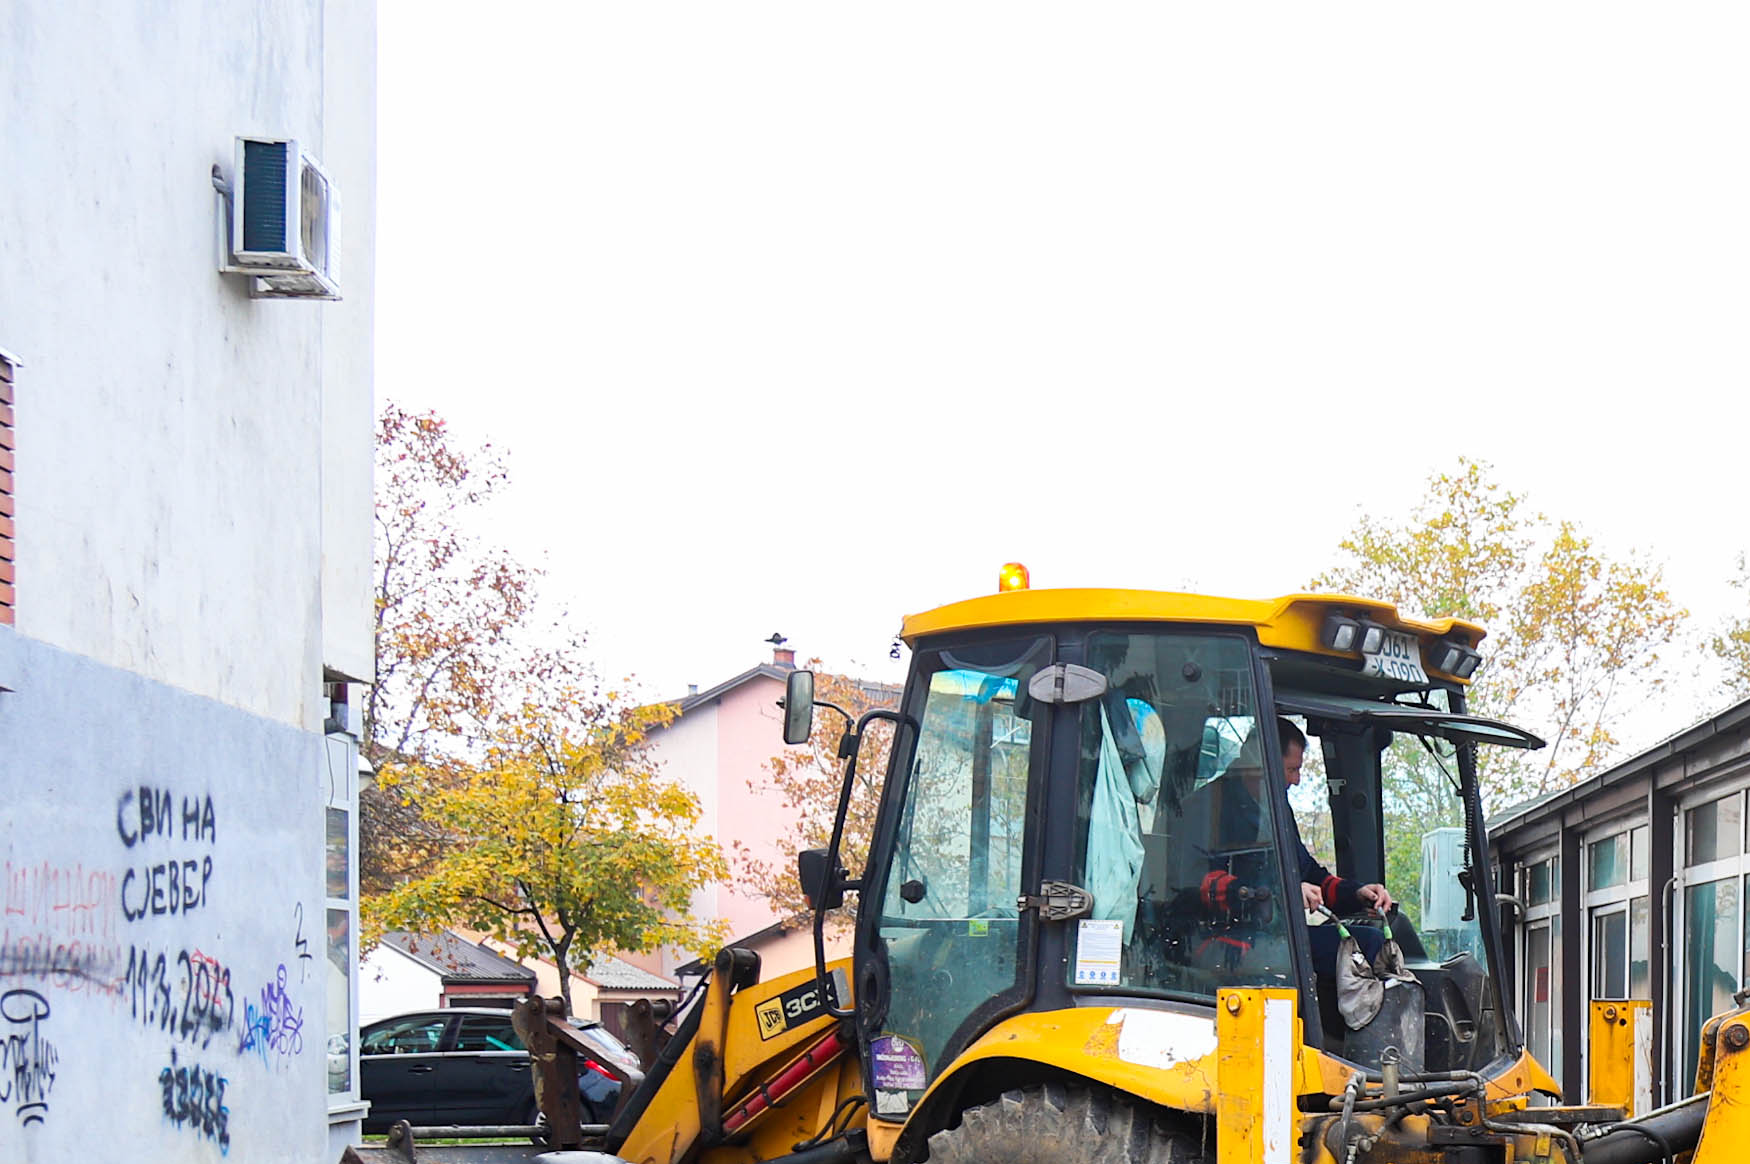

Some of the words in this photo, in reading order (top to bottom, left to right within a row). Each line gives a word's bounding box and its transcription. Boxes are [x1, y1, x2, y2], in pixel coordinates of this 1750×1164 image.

[117, 785, 172, 849] СВИ
[182, 792, 216, 845] НА
[121, 855, 213, 923] СЈЕВЕР
[763, 1009, 783, 1029] JCB
